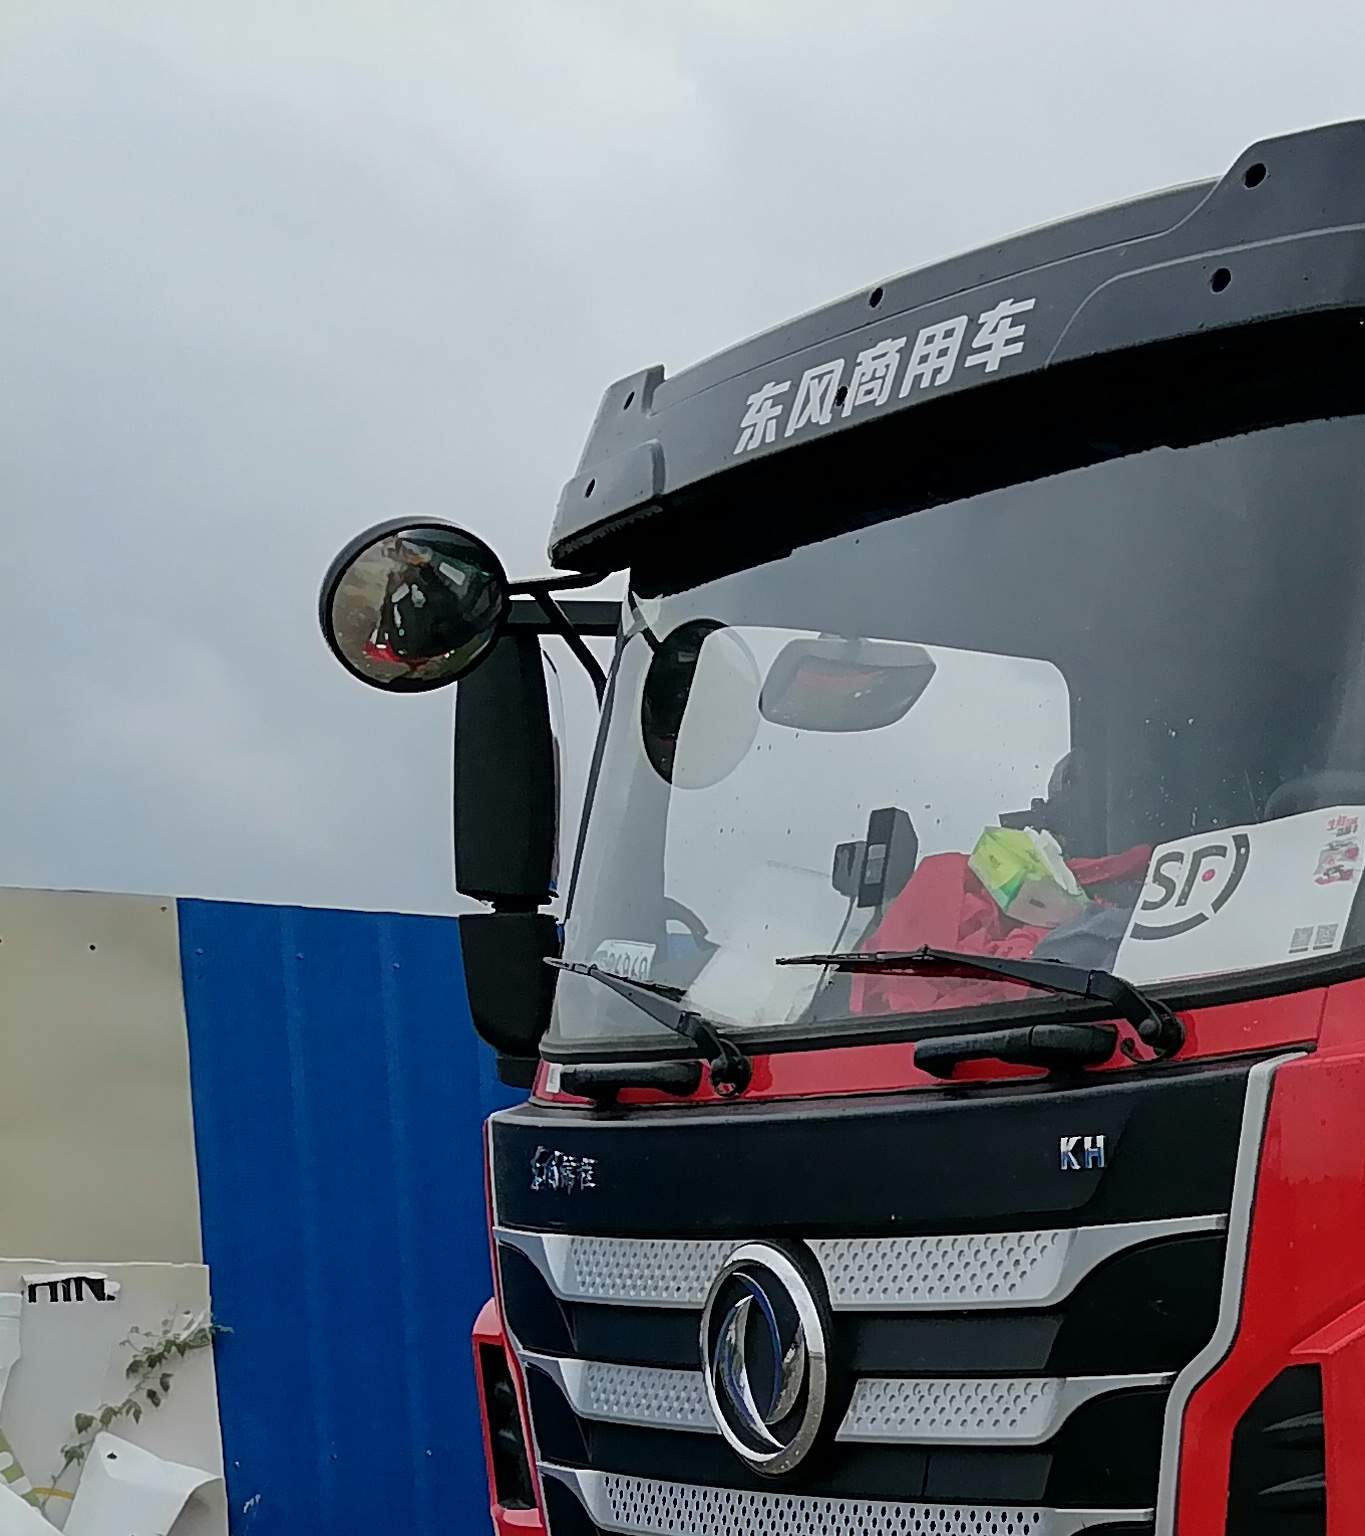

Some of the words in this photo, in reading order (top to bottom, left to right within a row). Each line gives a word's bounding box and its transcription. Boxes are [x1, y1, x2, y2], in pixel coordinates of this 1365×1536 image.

[733, 297, 1037, 456] 东风商用车
[1060, 1134, 1106, 1170] KH
